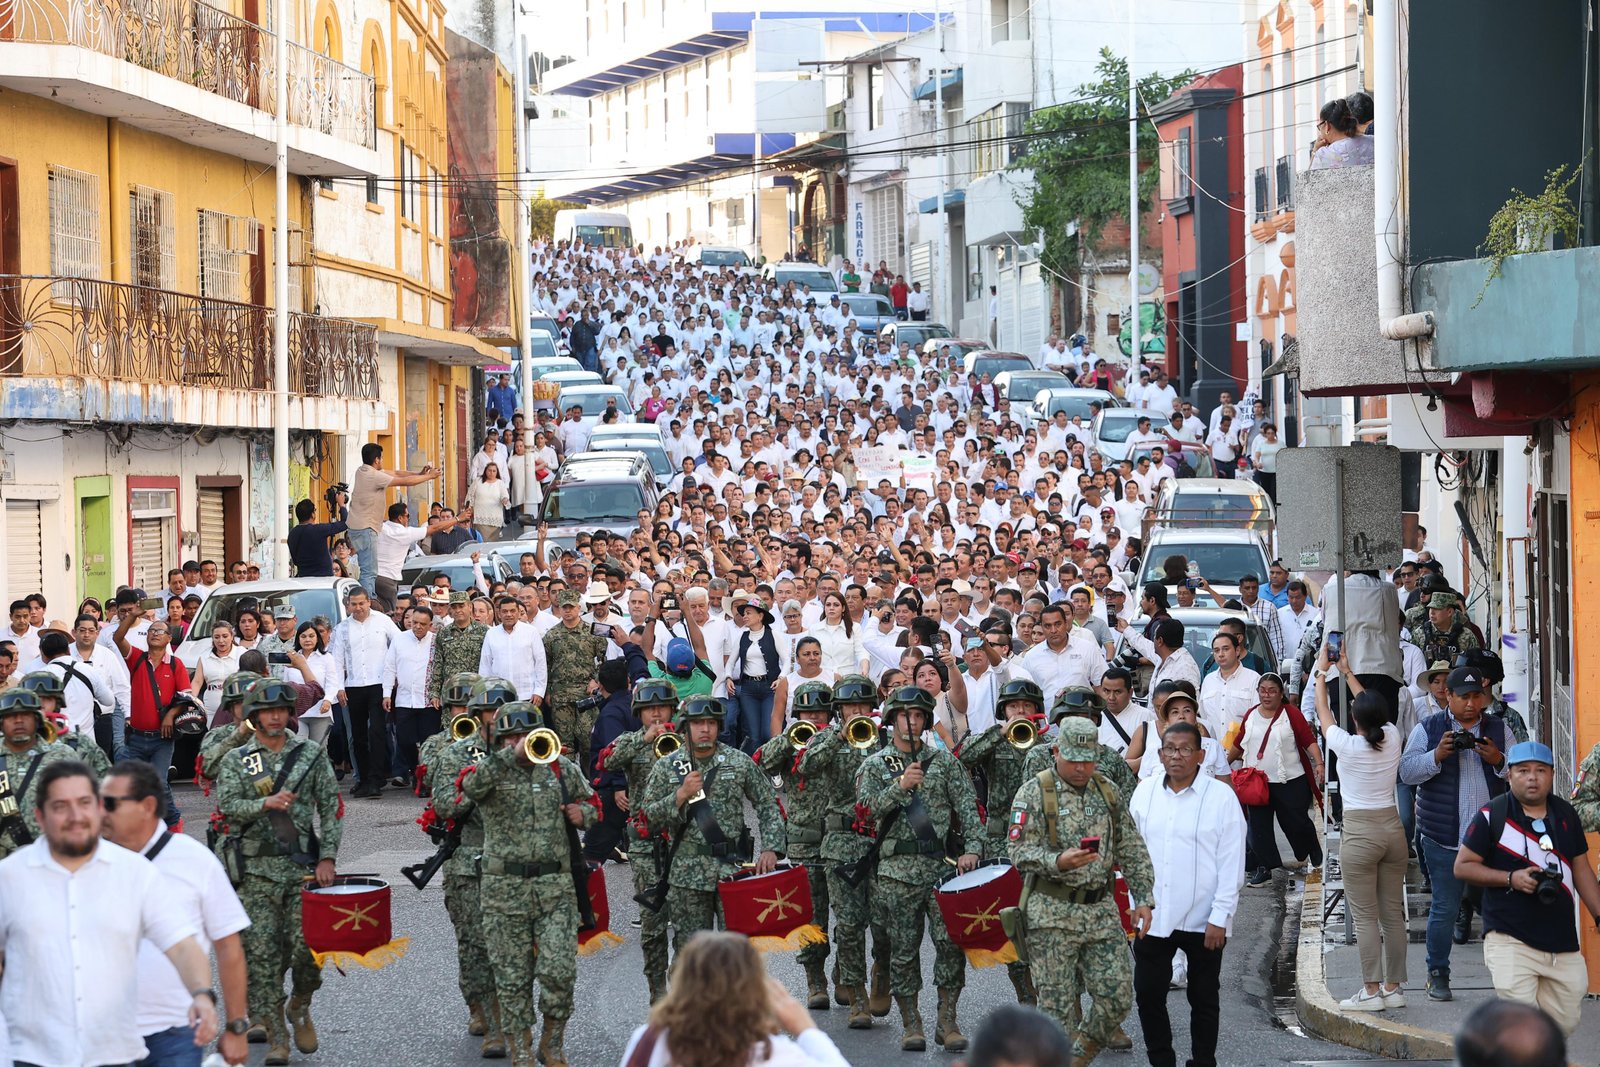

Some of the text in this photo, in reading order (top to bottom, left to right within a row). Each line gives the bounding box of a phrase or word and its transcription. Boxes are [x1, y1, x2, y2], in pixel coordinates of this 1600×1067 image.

[242, 752, 264, 776] 37
[672, 760, 692, 776] 37
[884, 755, 904, 773] 37
